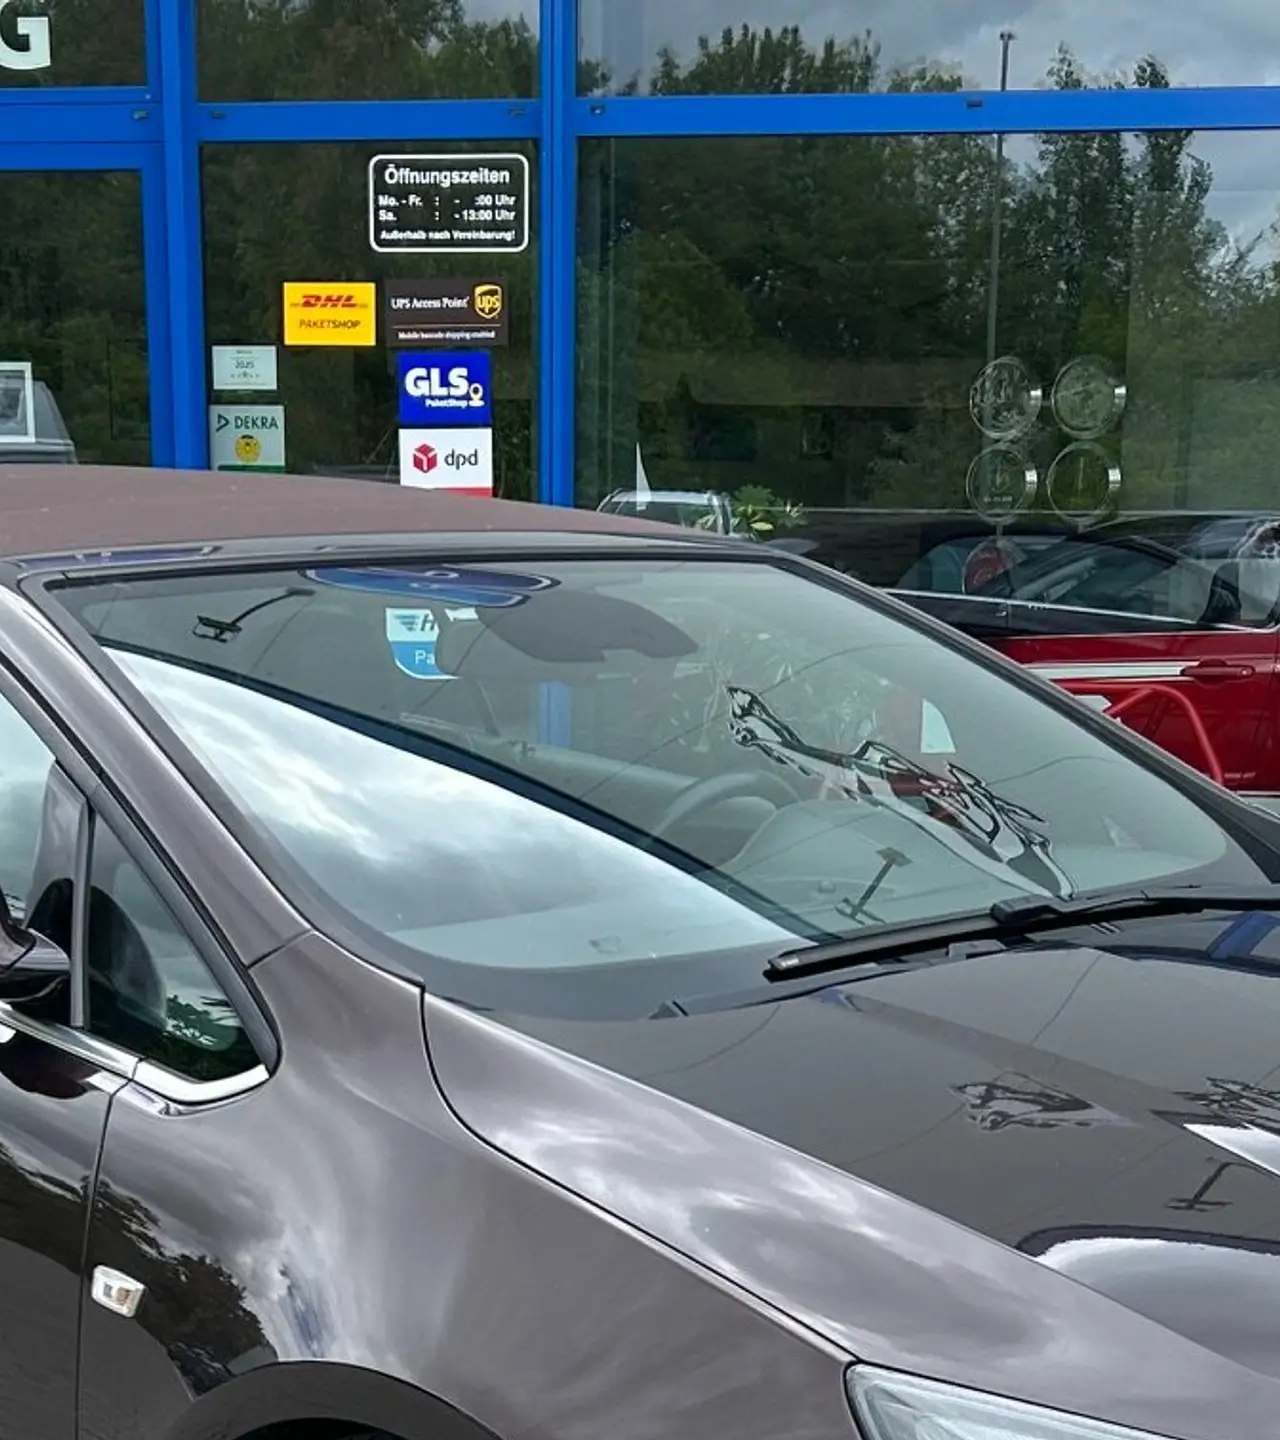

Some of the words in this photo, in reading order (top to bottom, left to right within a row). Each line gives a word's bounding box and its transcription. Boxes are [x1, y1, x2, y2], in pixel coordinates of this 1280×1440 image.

[384, 163, 510, 188] Öffnungszeiten
[378, 194, 399, 206] Mo.
[408, 194, 423, 206] Fr.
[495, 194, 516, 206] Uhr
[378, 209, 397, 221] Sa.
[463, 209, 492, 221] 13:00
[495, 209, 516, 221] Uhr
[380, 230, 426, 240] Außerhalb
[429, 231, 451, 240] nach
[301, 294, 357, 308] DHL
[391, 297, 411, 309] UPS
[412, 297, 441, 308] Access
[442, 296, 468, 308] Point
[299, 318, 361, 330] PAKETSHOP
[405, 367, 469, 397] GLS
[234, 415, 279, 429] DEKRA
[444, 448, 478, 470] dpd
